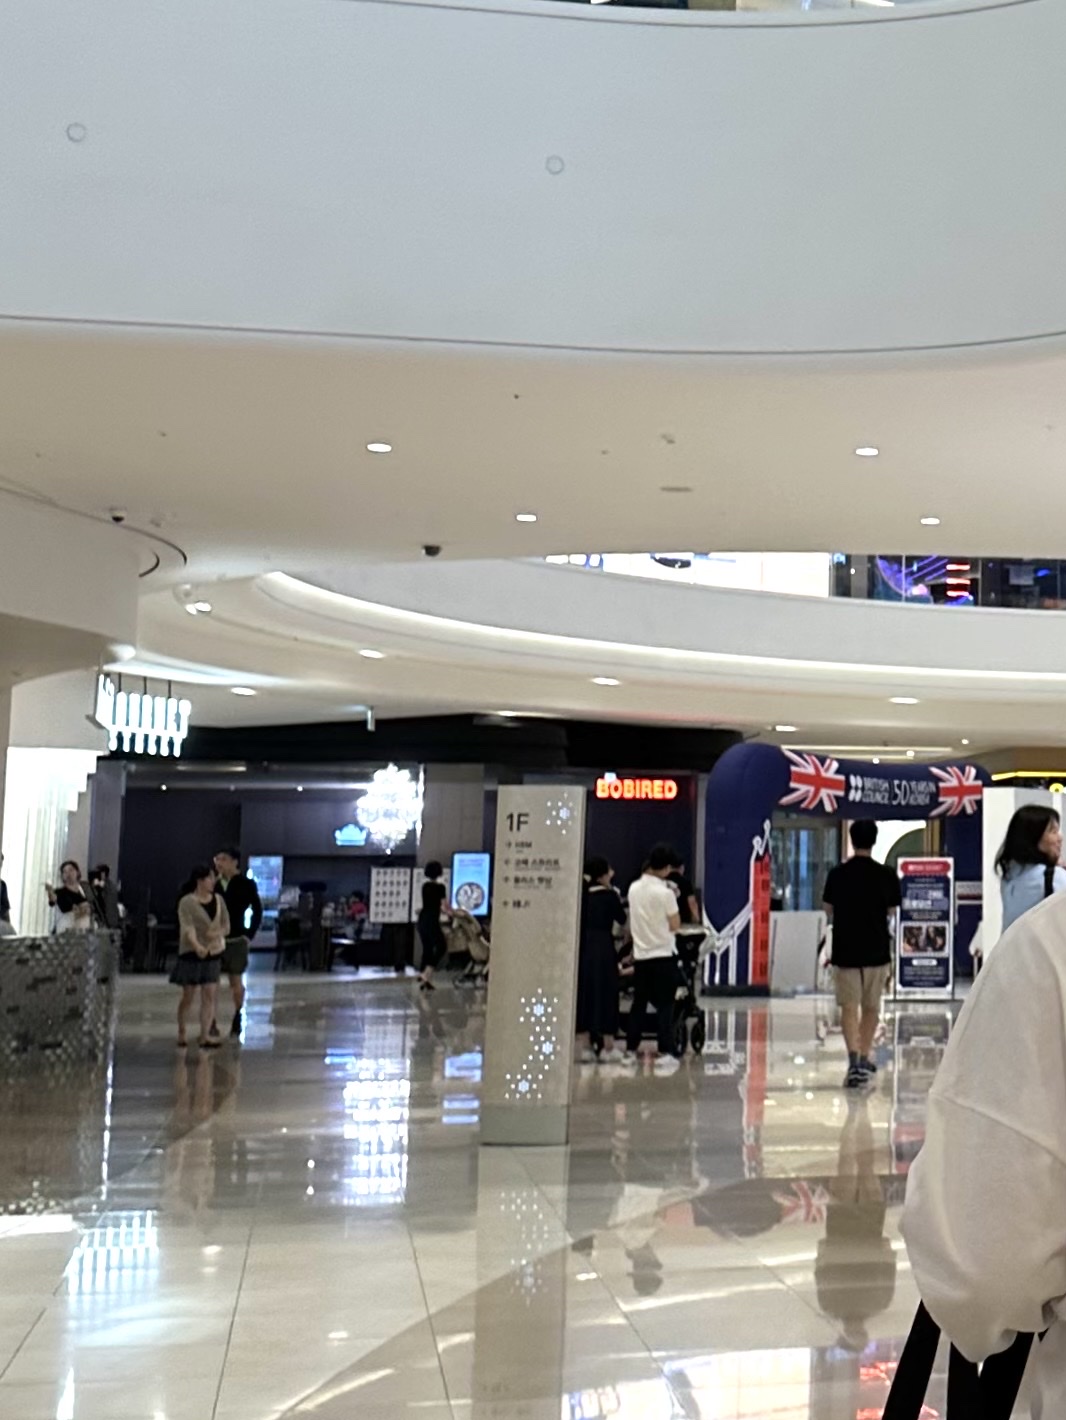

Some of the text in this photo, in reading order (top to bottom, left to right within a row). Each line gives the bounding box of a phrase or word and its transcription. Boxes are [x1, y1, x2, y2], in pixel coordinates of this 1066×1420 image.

[596, 777, 678, 799] BOBIRED
[892, 780, 910, 806] 50
[506, 812, 529, 832] 1F
